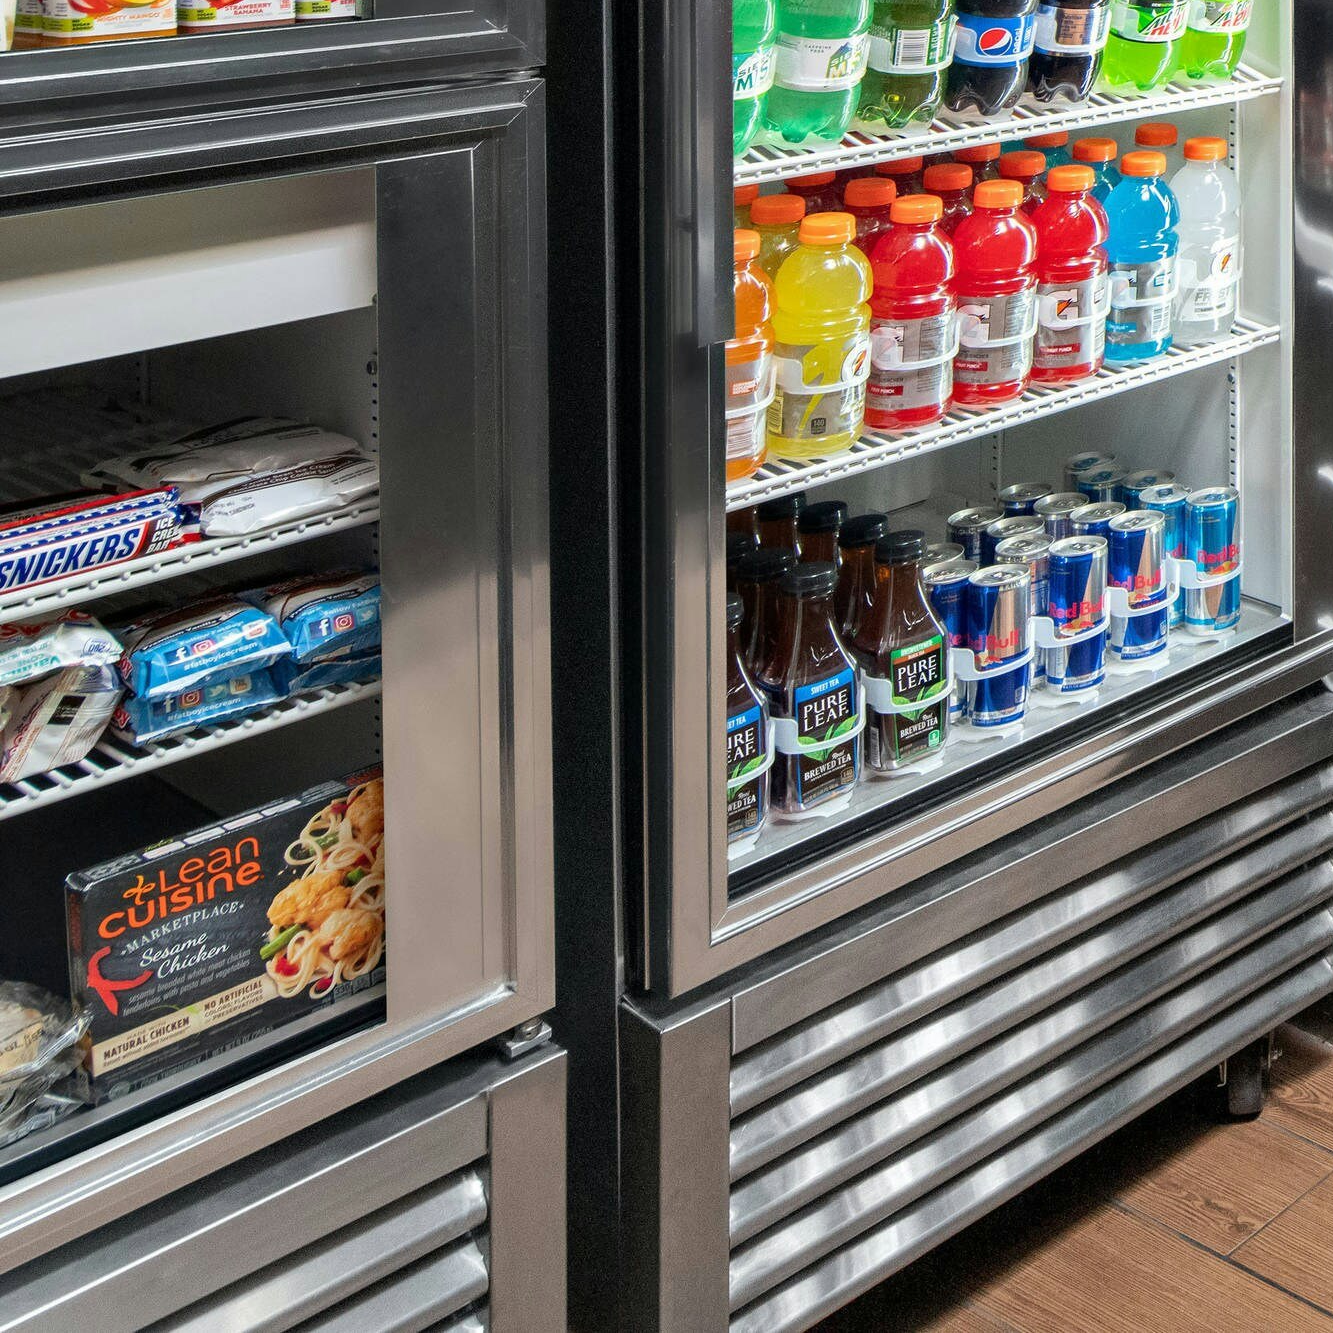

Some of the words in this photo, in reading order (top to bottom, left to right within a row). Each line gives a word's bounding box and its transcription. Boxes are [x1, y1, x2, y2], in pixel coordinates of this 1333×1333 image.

[155, 517, 175, 531] ICE
[0, 528, 140, 589] SNICKERS
[986, 629, 1020, 652] Bull
[896, 654, 938, 681] PURE
[810, 681, 829, 696] SWEET
[828, 677, 840, 689] TEA
[802, 689, 848, 719] PURE
[900, 720, 927, 740] BREWED
[926, 717, 939, 729] TEA
[803, 759, 838, 781] BREWED
[836, 752, 852, 767] TEA
[126, 900, 239, 955] MARKETPLACE
[138, 930, 209, 968] Sesame
[157, 942, 230, 980] Chicken
[203, 998, 217, 1011] NO
[218, 980, 264, 1007] ARTIFICIAL
[103, 1036, 148, 1061] NATURAL
[149, 1016, 191, 1039] CHICKEN
